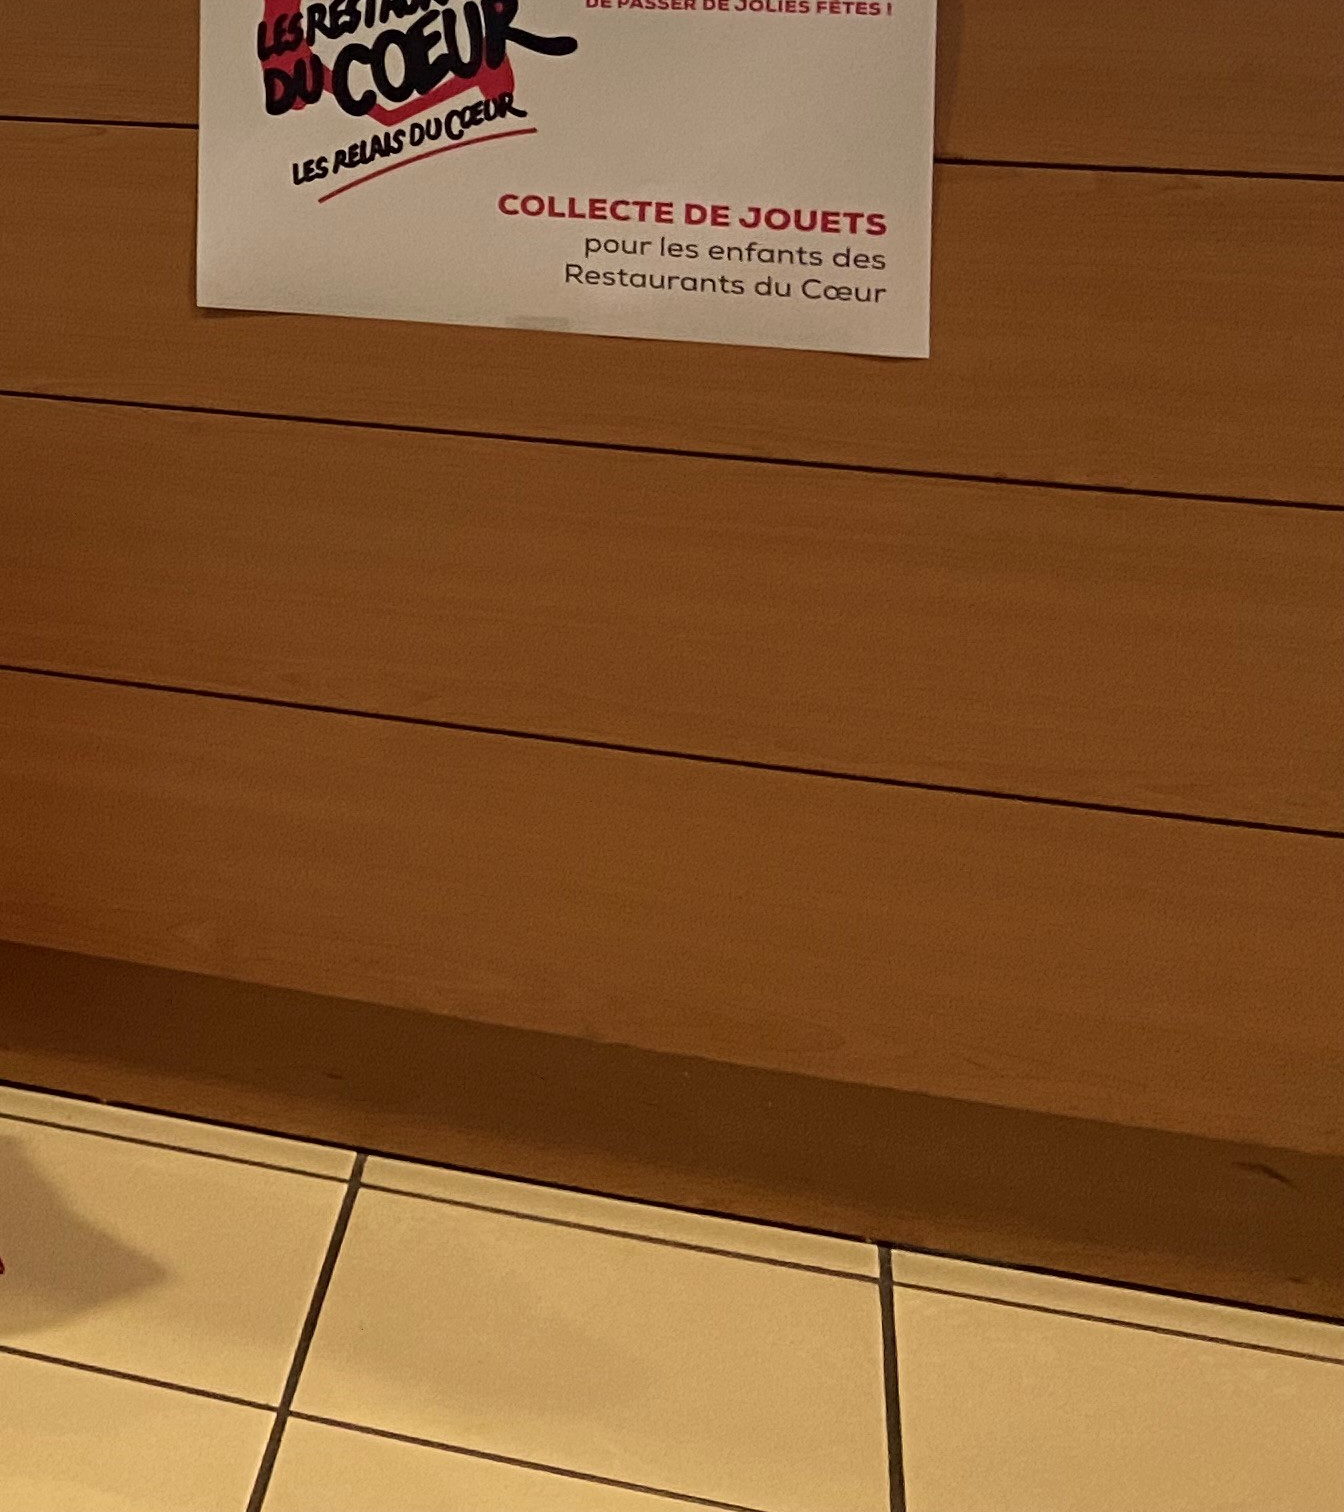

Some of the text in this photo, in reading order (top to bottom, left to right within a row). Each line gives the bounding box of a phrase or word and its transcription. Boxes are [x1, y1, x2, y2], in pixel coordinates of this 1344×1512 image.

[257, 12, 304, 61] LES
[263, 53, 325, 116] DU
[292, 156, 329, 185] LES
[332, 128, 406, 174] RELAIS
[409, 116, 443, 147] DU
[497, 193, 888, 236] COLLECTE DE JOUETS
[584, 235, 887, 270] pour les enfants des
[564, 263, 887, 303] Restaurants du Cœur
